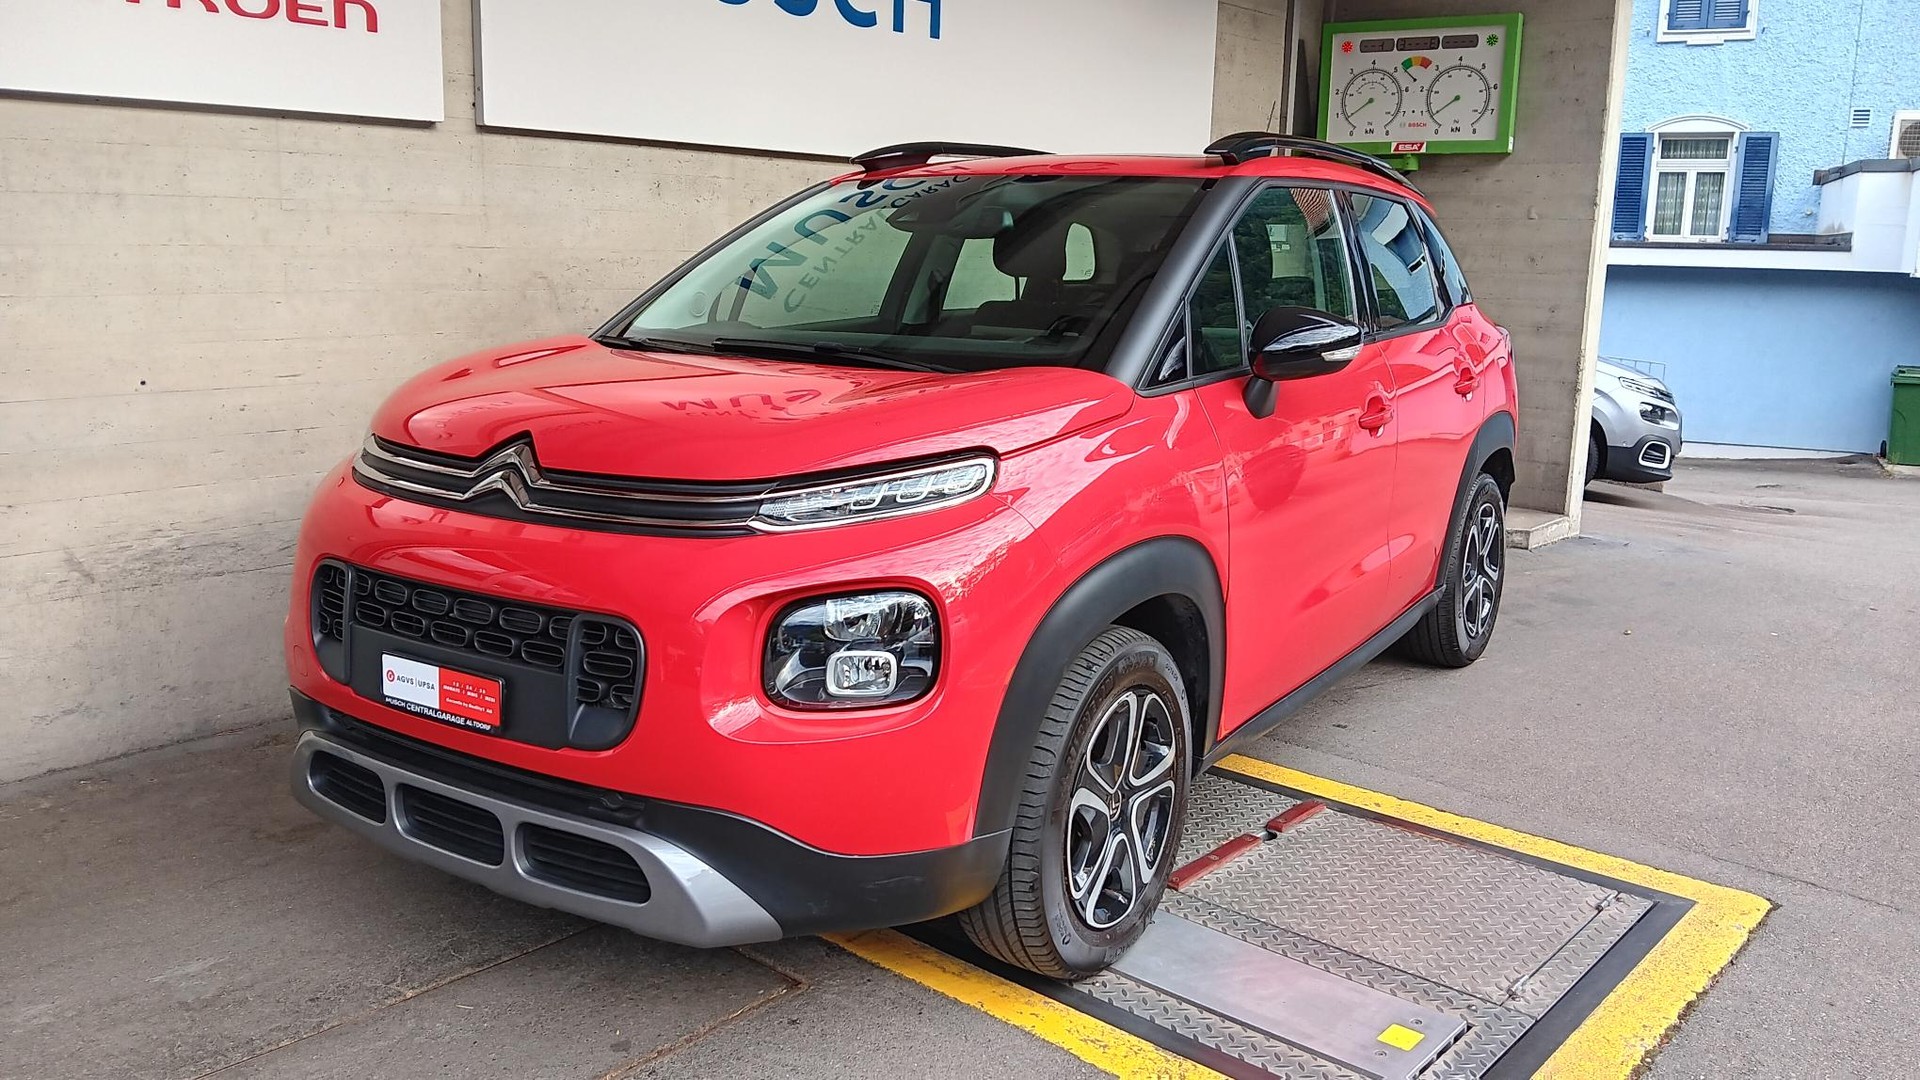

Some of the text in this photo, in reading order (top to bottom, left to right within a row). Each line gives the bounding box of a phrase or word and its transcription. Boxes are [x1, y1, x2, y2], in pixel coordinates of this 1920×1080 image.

[396, 675, 436, 691] AGVS UPSA
[465, 719, 492, 731] ALTDORF
